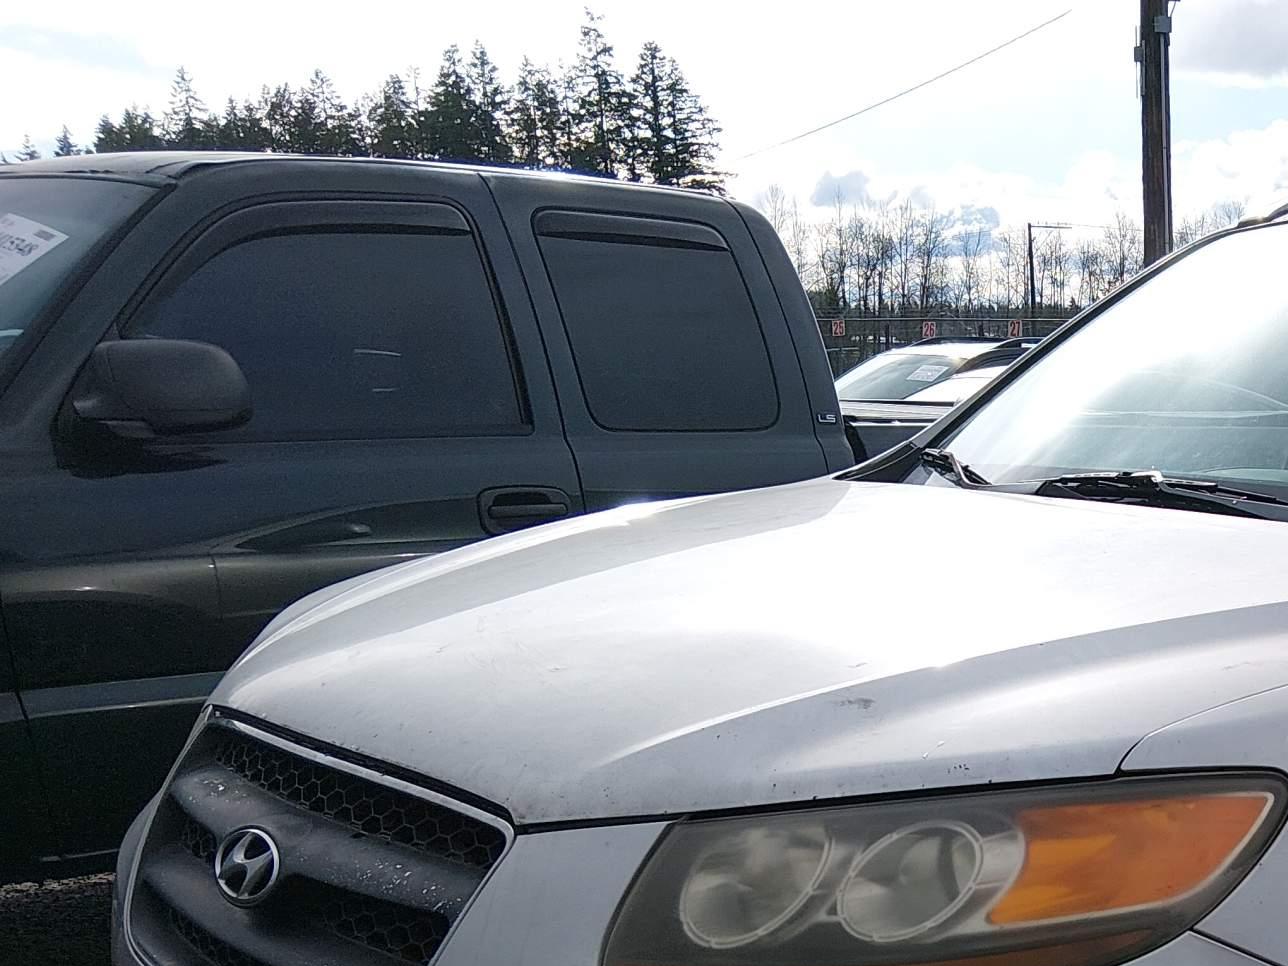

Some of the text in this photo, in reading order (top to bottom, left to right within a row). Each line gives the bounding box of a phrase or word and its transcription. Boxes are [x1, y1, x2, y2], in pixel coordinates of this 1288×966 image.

[832, 321, 844, 335] 25
[923, 323, 935, 337] 26
[1009, 321, 1021, 336] 27
[817, 414, 836, 423] LS
